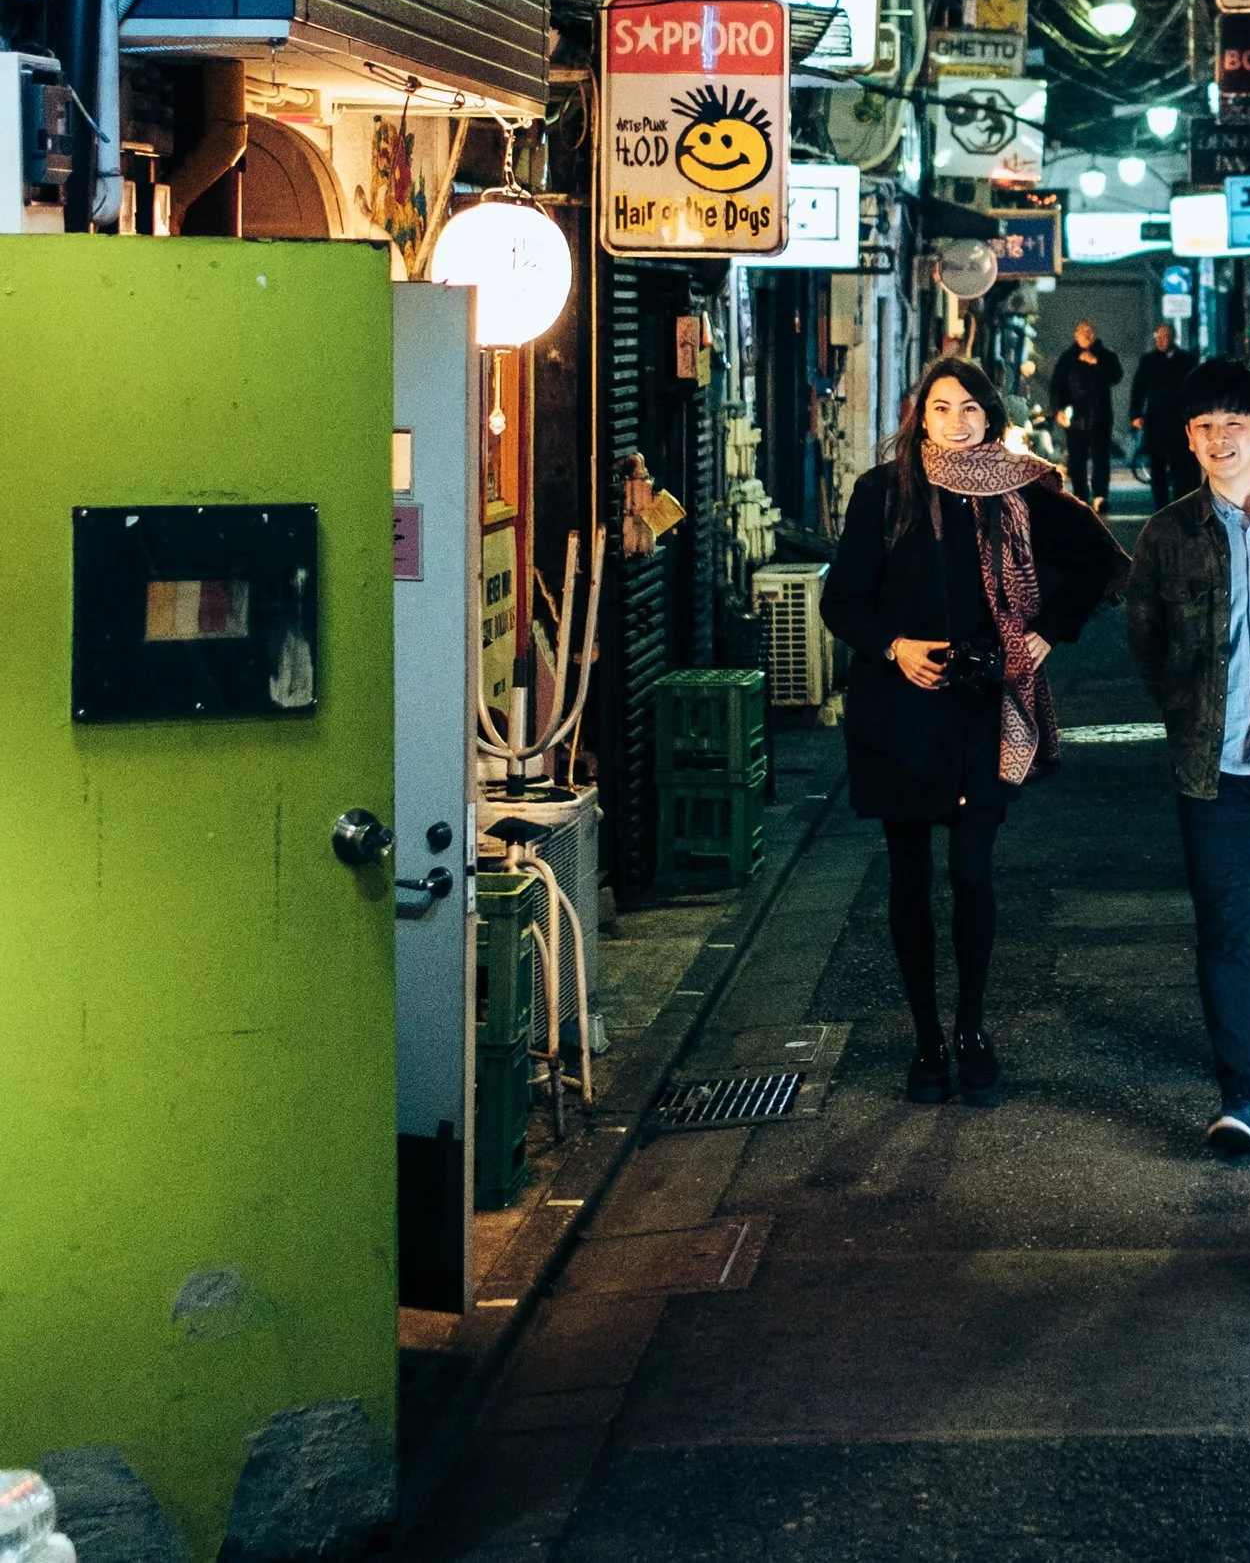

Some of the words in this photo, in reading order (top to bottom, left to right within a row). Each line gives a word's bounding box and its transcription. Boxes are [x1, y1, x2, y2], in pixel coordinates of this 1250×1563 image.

[937, 39, 1017, 59] GHETTO
[614, 195, 656, 230] Hair
[724, 199, 771, 237] Dogs
